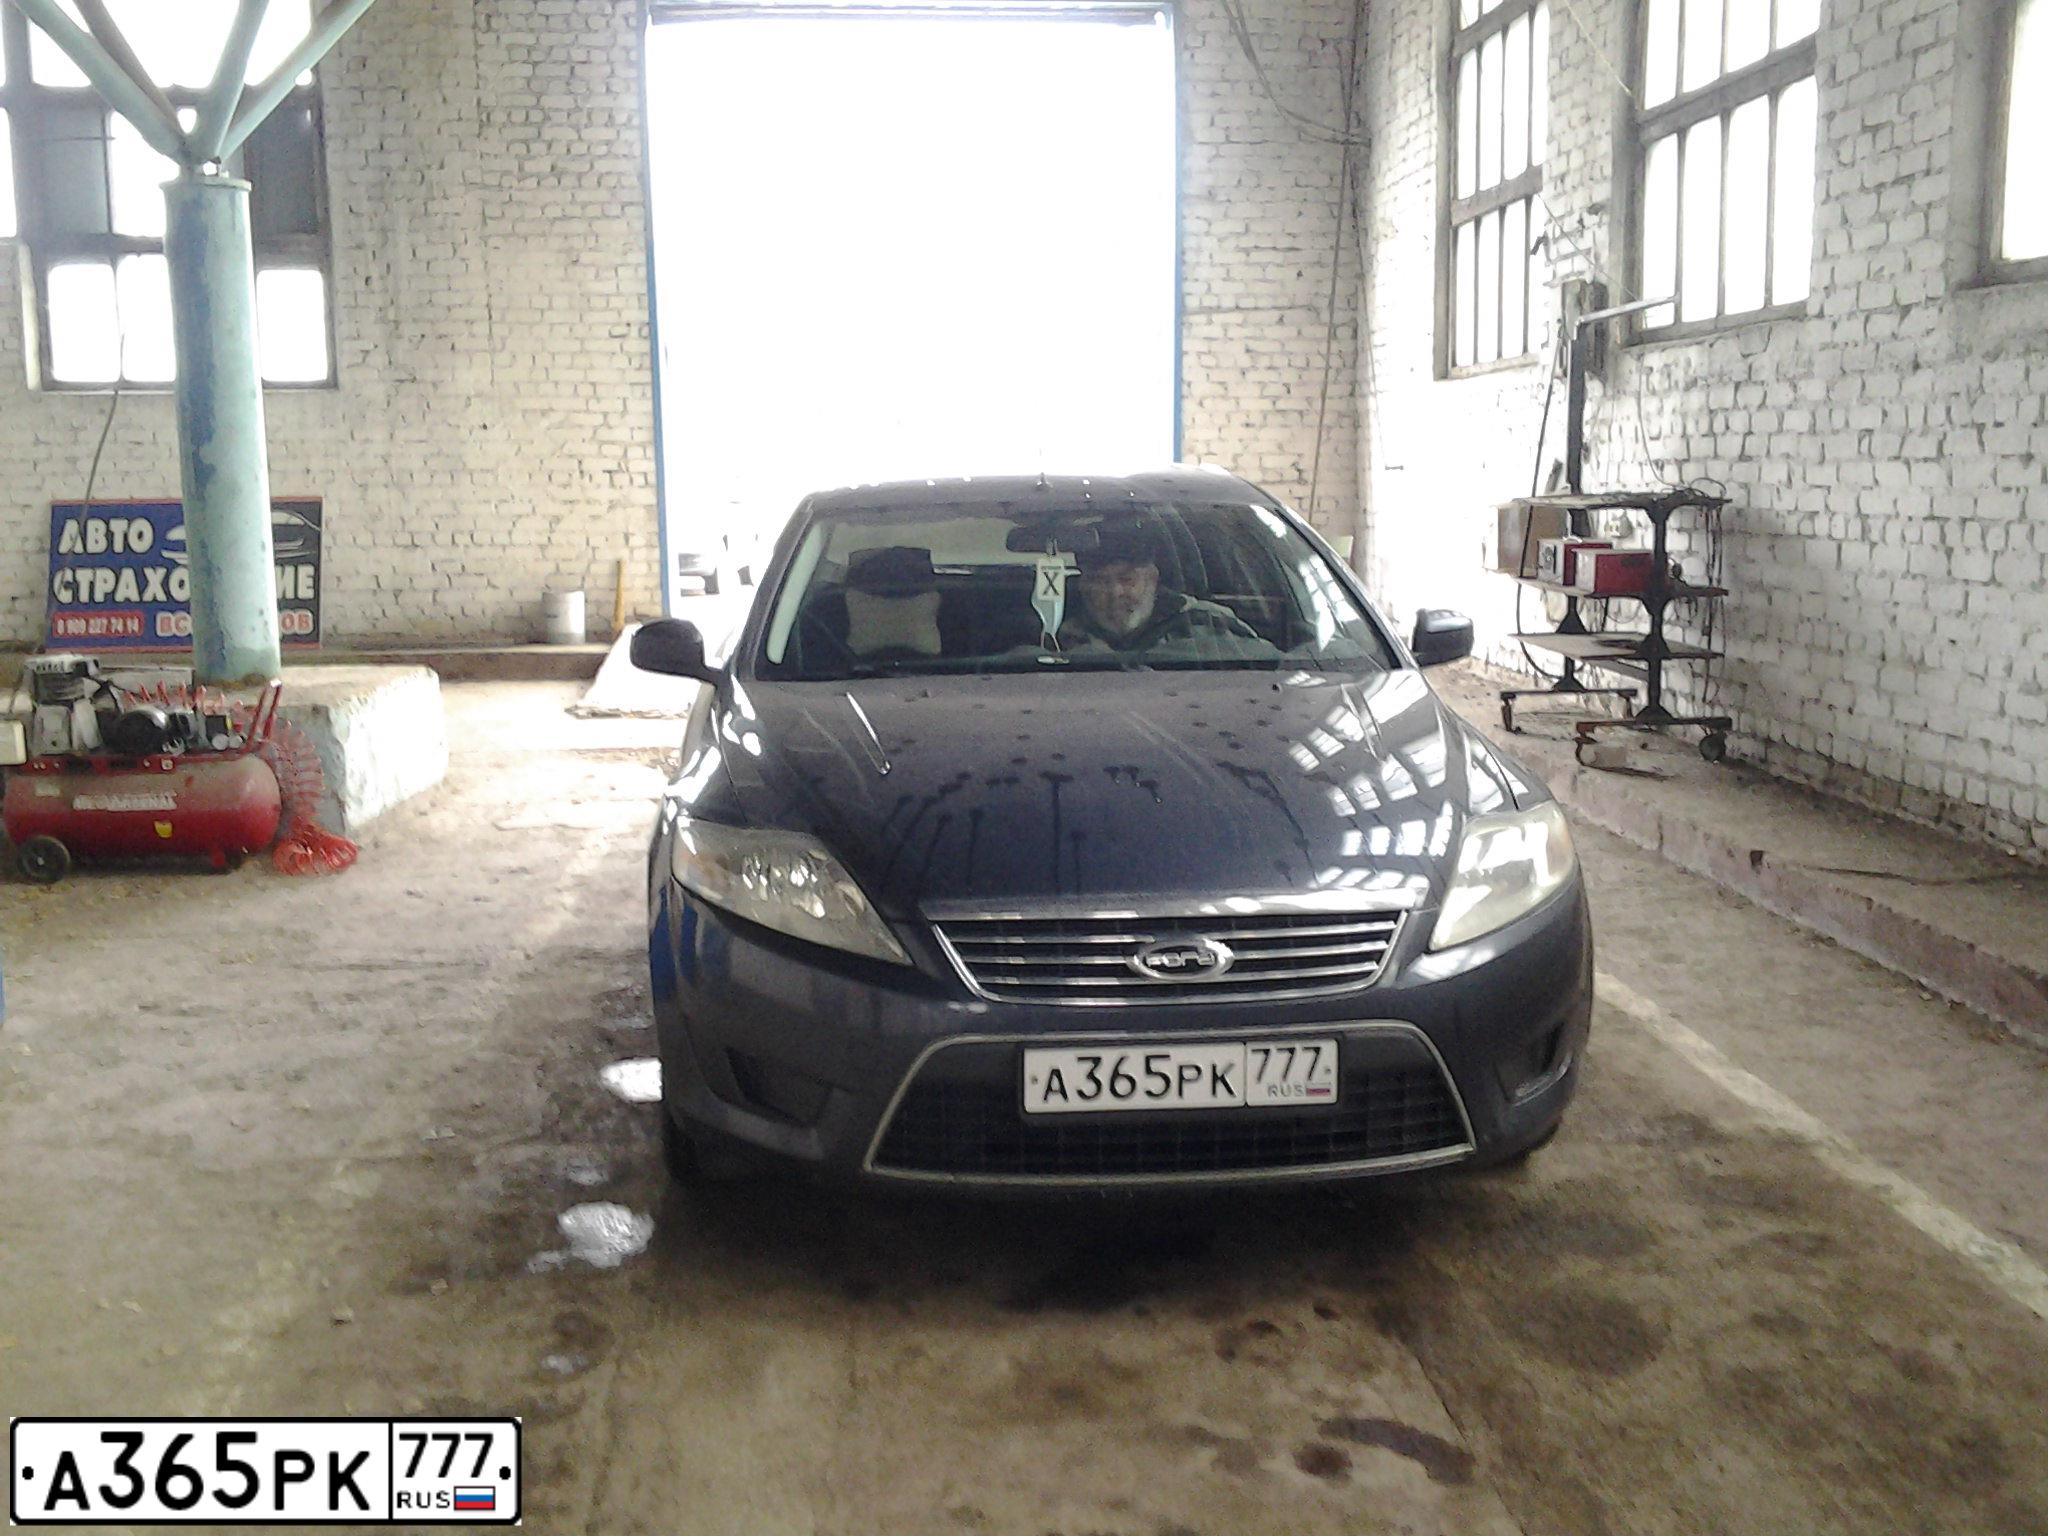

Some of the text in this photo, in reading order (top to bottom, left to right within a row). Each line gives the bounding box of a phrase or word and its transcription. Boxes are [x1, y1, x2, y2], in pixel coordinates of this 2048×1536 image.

[58, 517, 154, 555] АВТО
[53, 564, 315, 604] СТРАХОИЕ
[1043, 1046, 1322, 1102] A365PK 777
[1267, 1084, 1305, 1097] RUS
